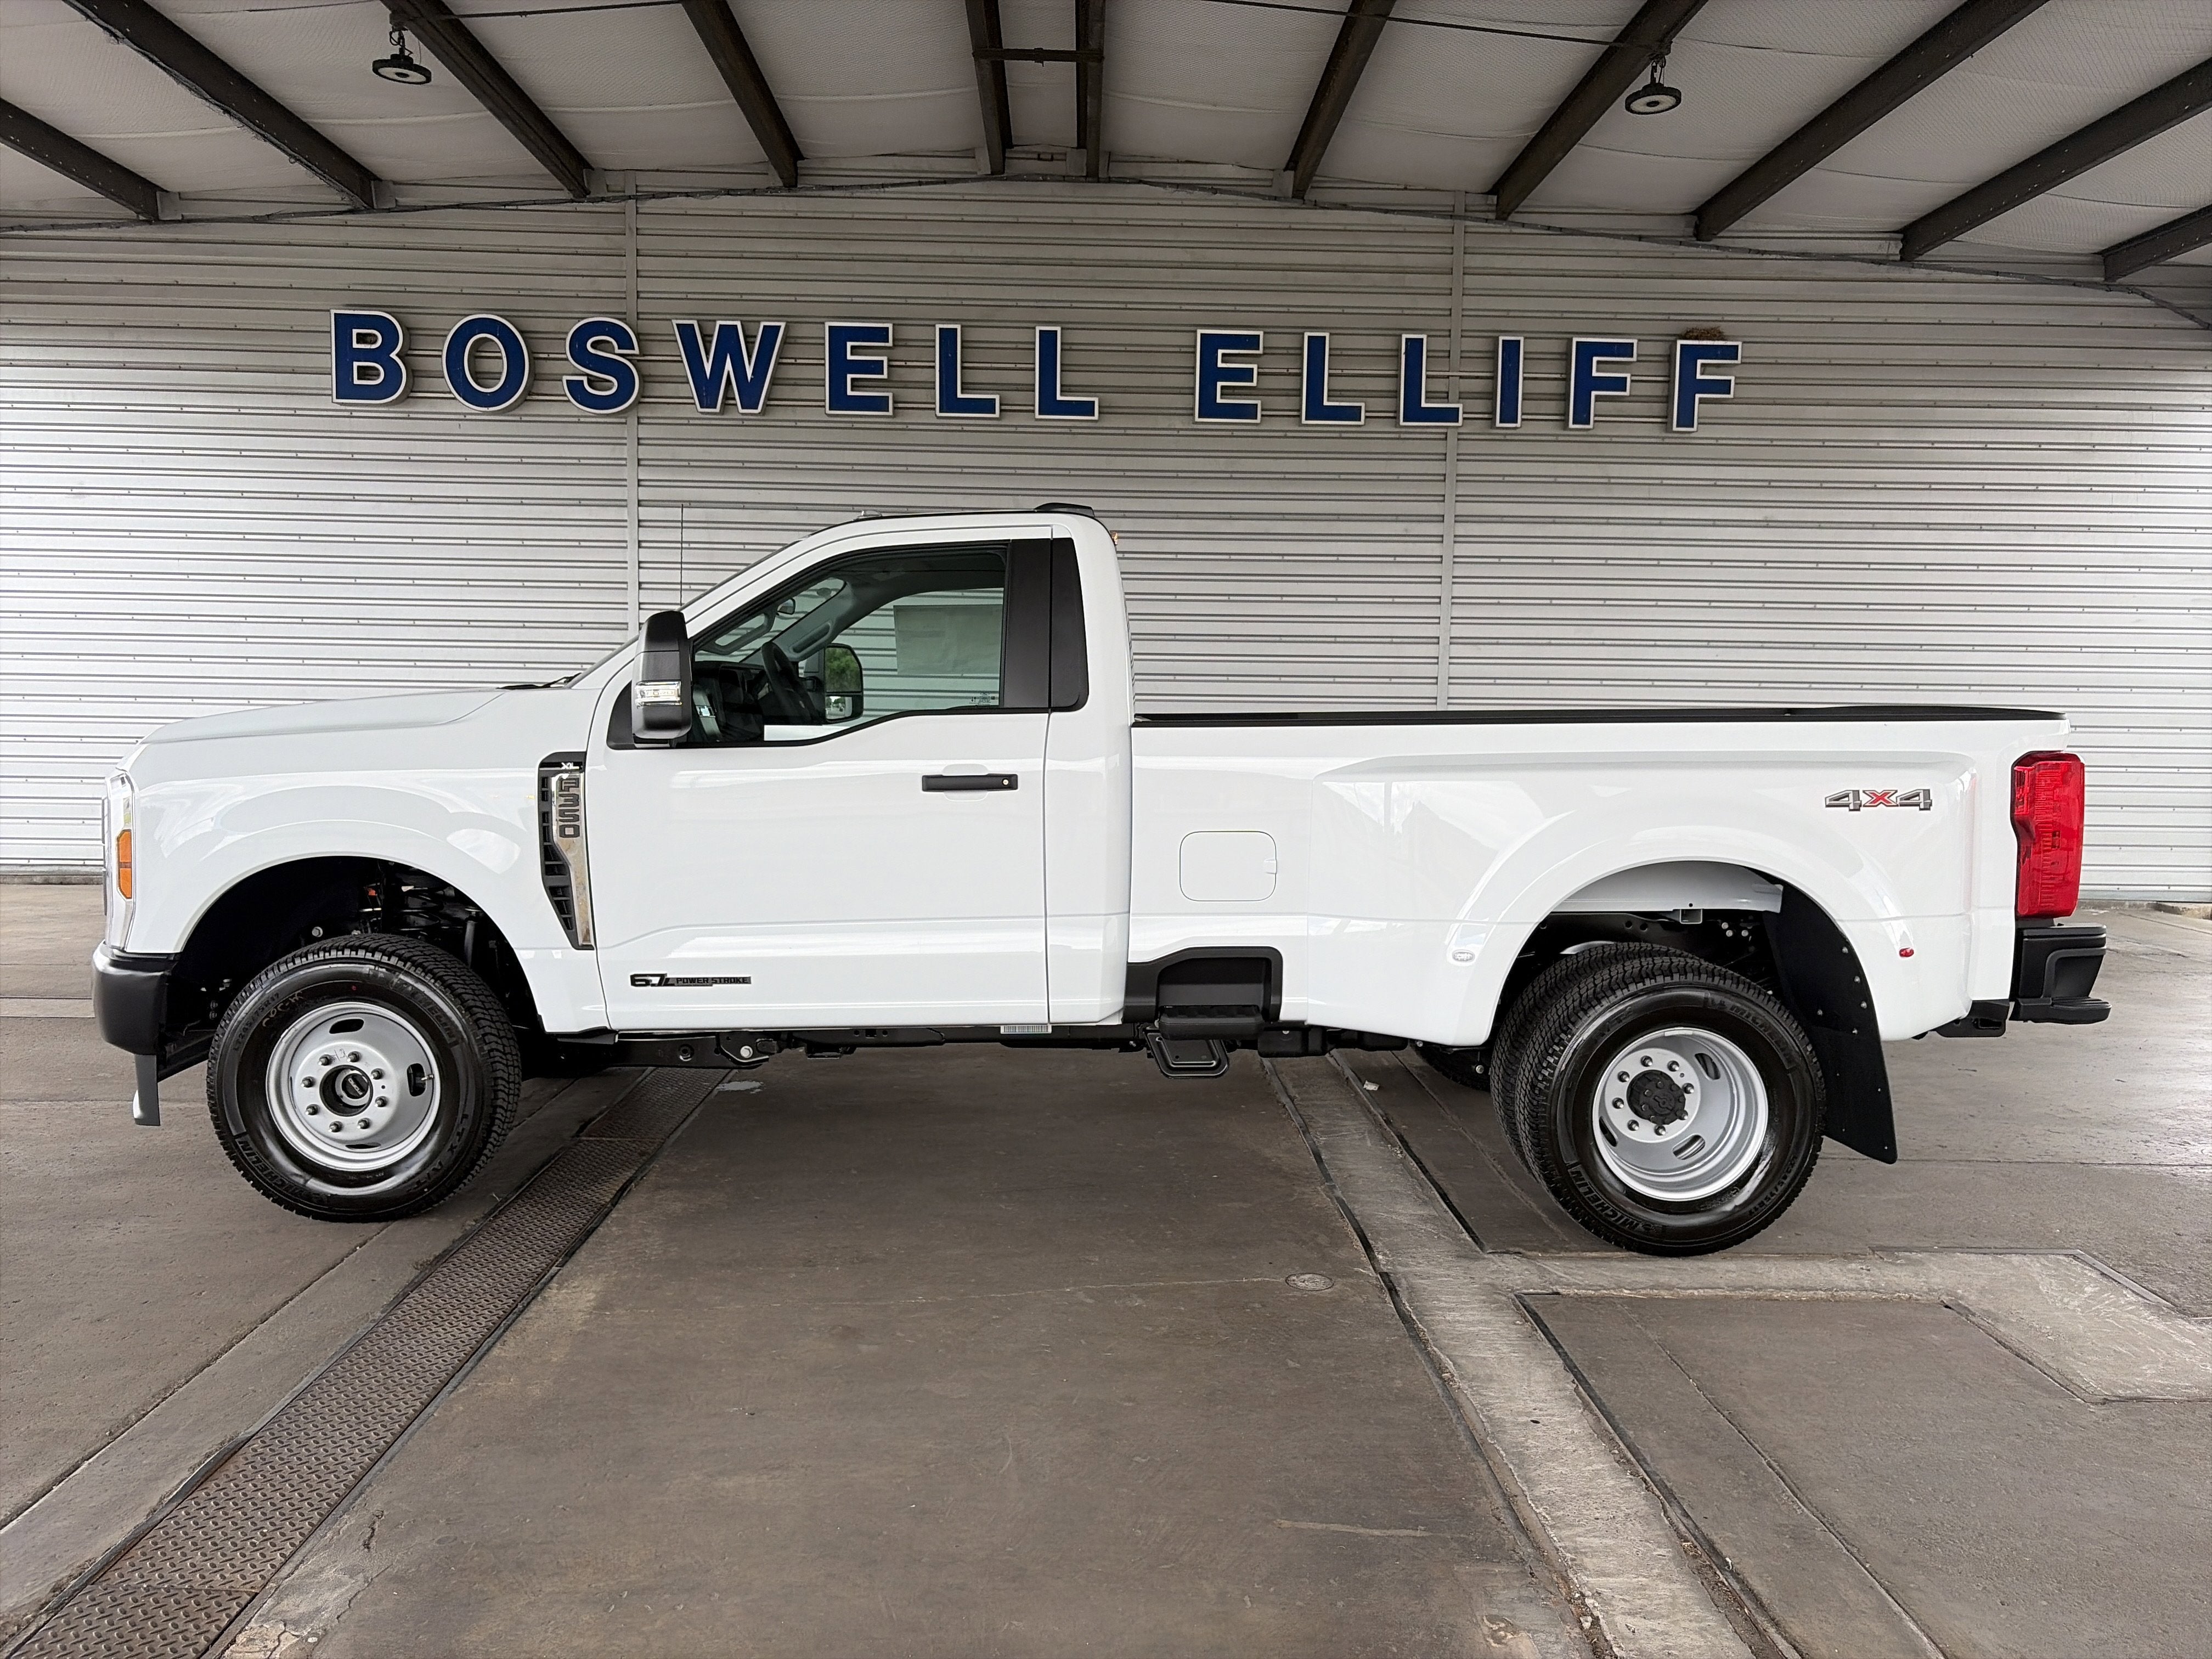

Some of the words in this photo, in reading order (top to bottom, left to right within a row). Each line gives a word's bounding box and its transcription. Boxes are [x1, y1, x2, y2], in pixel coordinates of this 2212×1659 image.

[330, 309, 1099, 420] BOSWELL
[1194, 330, 1742, 432] ELLIFF
[558, 777, 580, 838] F350
[447, 1113, 470, 1155] LTX
[238, 1140, 305, 1197] MICHELIN
[1570, 1170, 1639, 1229] MICHELIN
